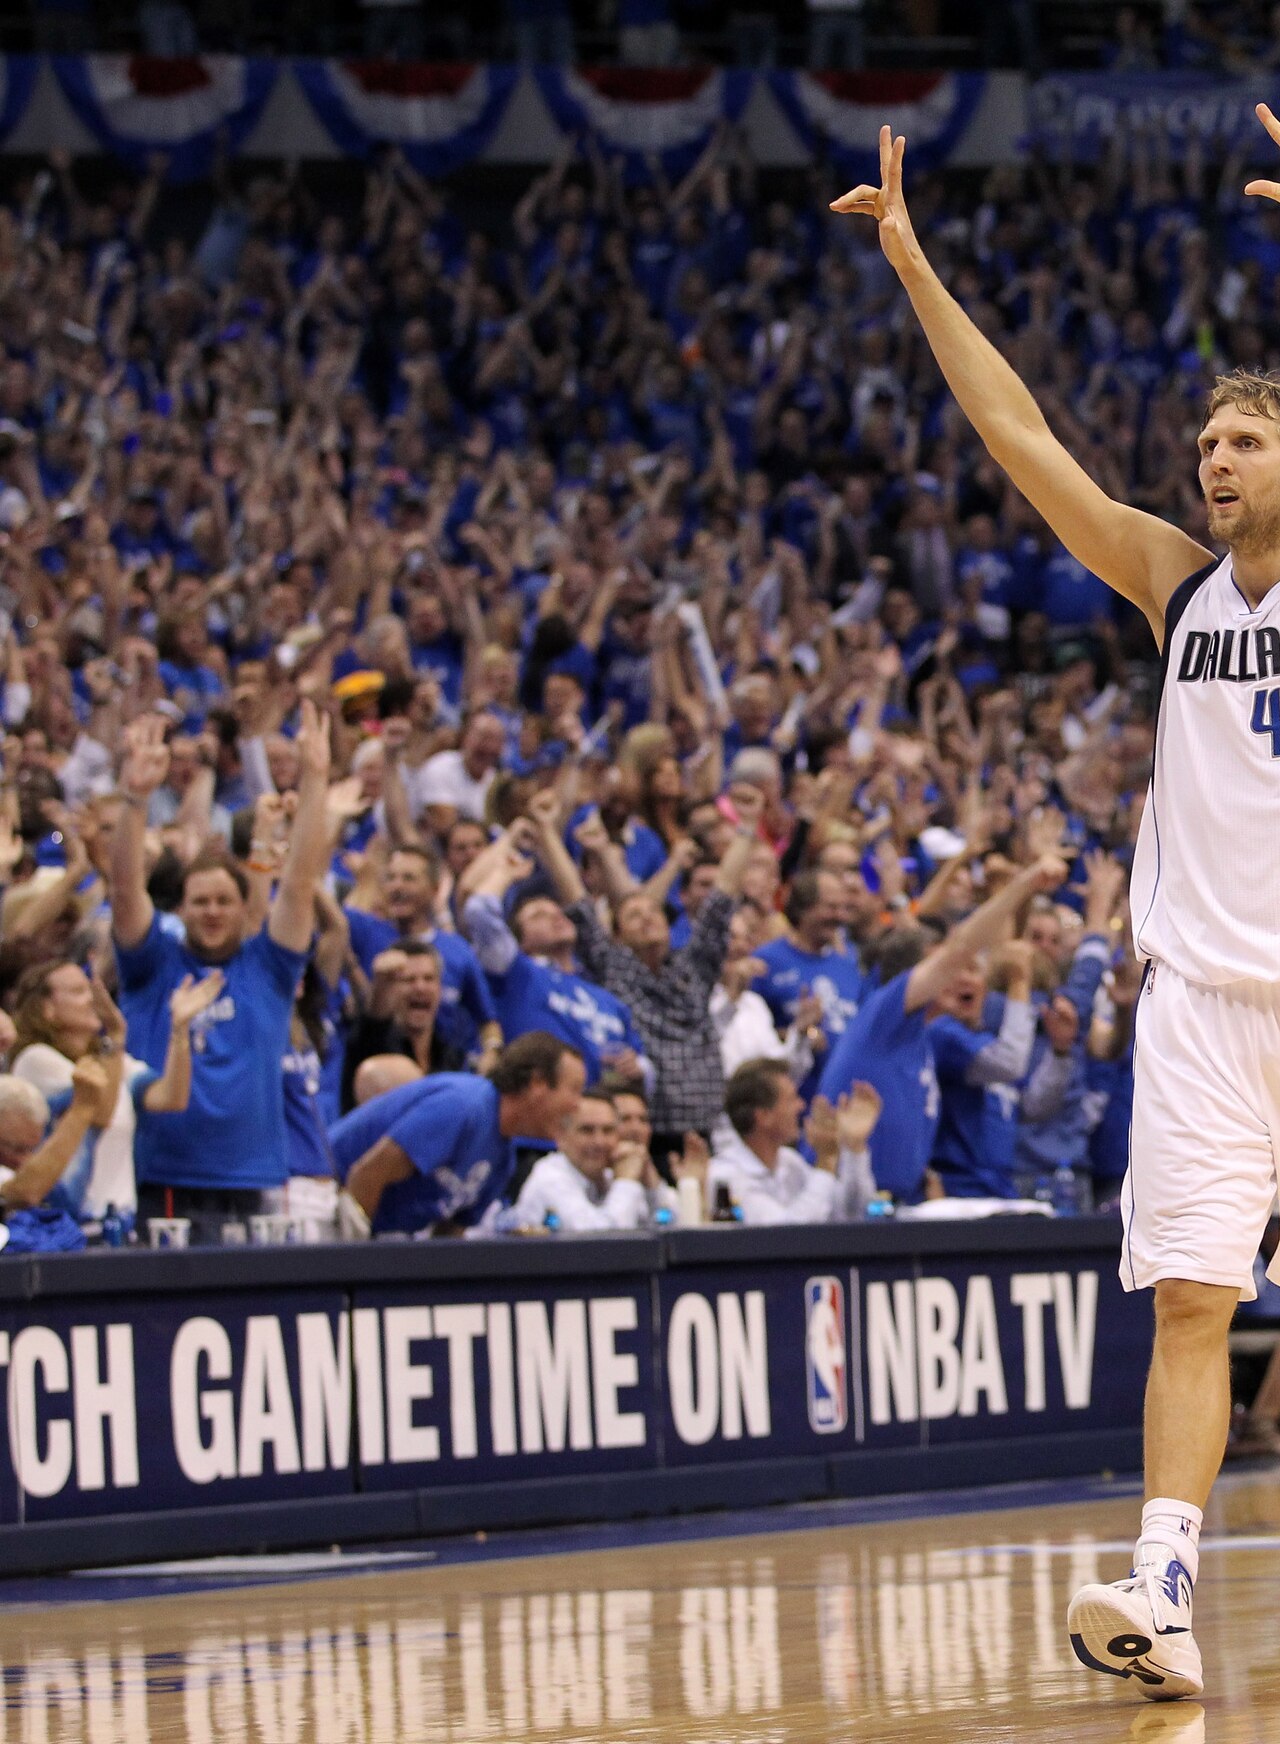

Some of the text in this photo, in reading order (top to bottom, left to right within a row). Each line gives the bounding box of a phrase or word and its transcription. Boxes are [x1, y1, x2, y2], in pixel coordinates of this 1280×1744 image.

[0, 1270, 1099, 1498] CH GAMETIME ON NBA TV
